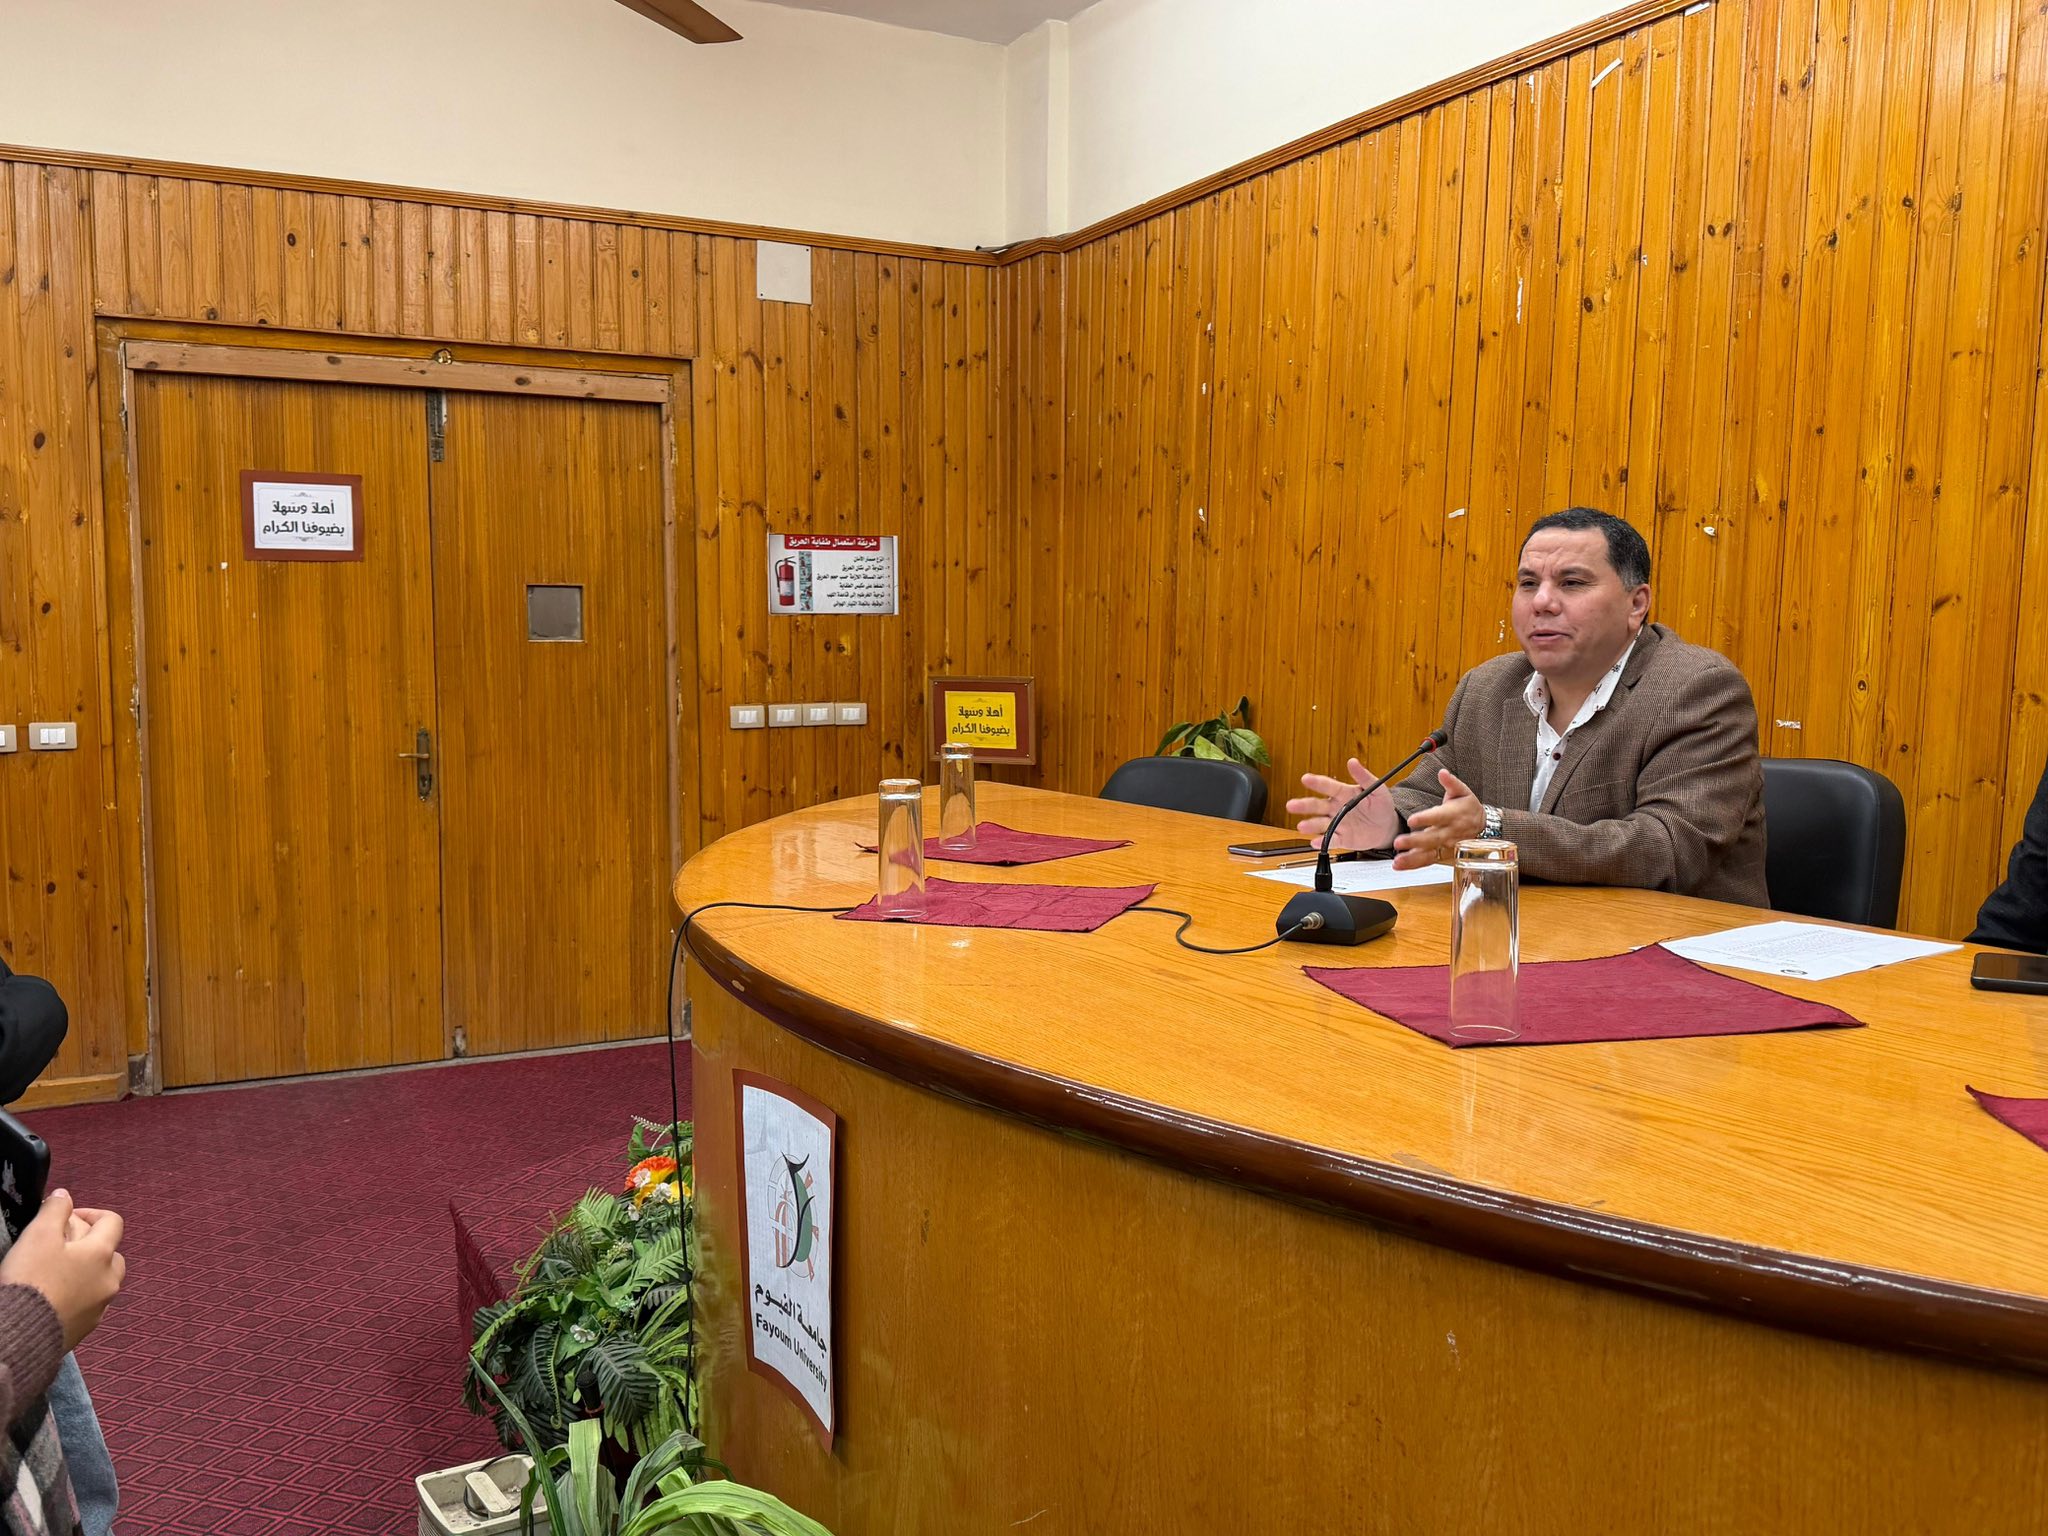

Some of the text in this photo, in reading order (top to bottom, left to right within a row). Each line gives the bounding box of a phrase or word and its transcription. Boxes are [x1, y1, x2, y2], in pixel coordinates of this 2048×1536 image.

[263, 520, 345, 537] بضيوفنا الكرام
[788, 535, 878, 549] طريقة استعمال طفاية الحريق
[952, 722, 1010, 737] بضيوفنا الكرام
[754, 1283, 827, 1359] جامعة الفيوم
[755, 1312, 828, 1393] Fayoum University
